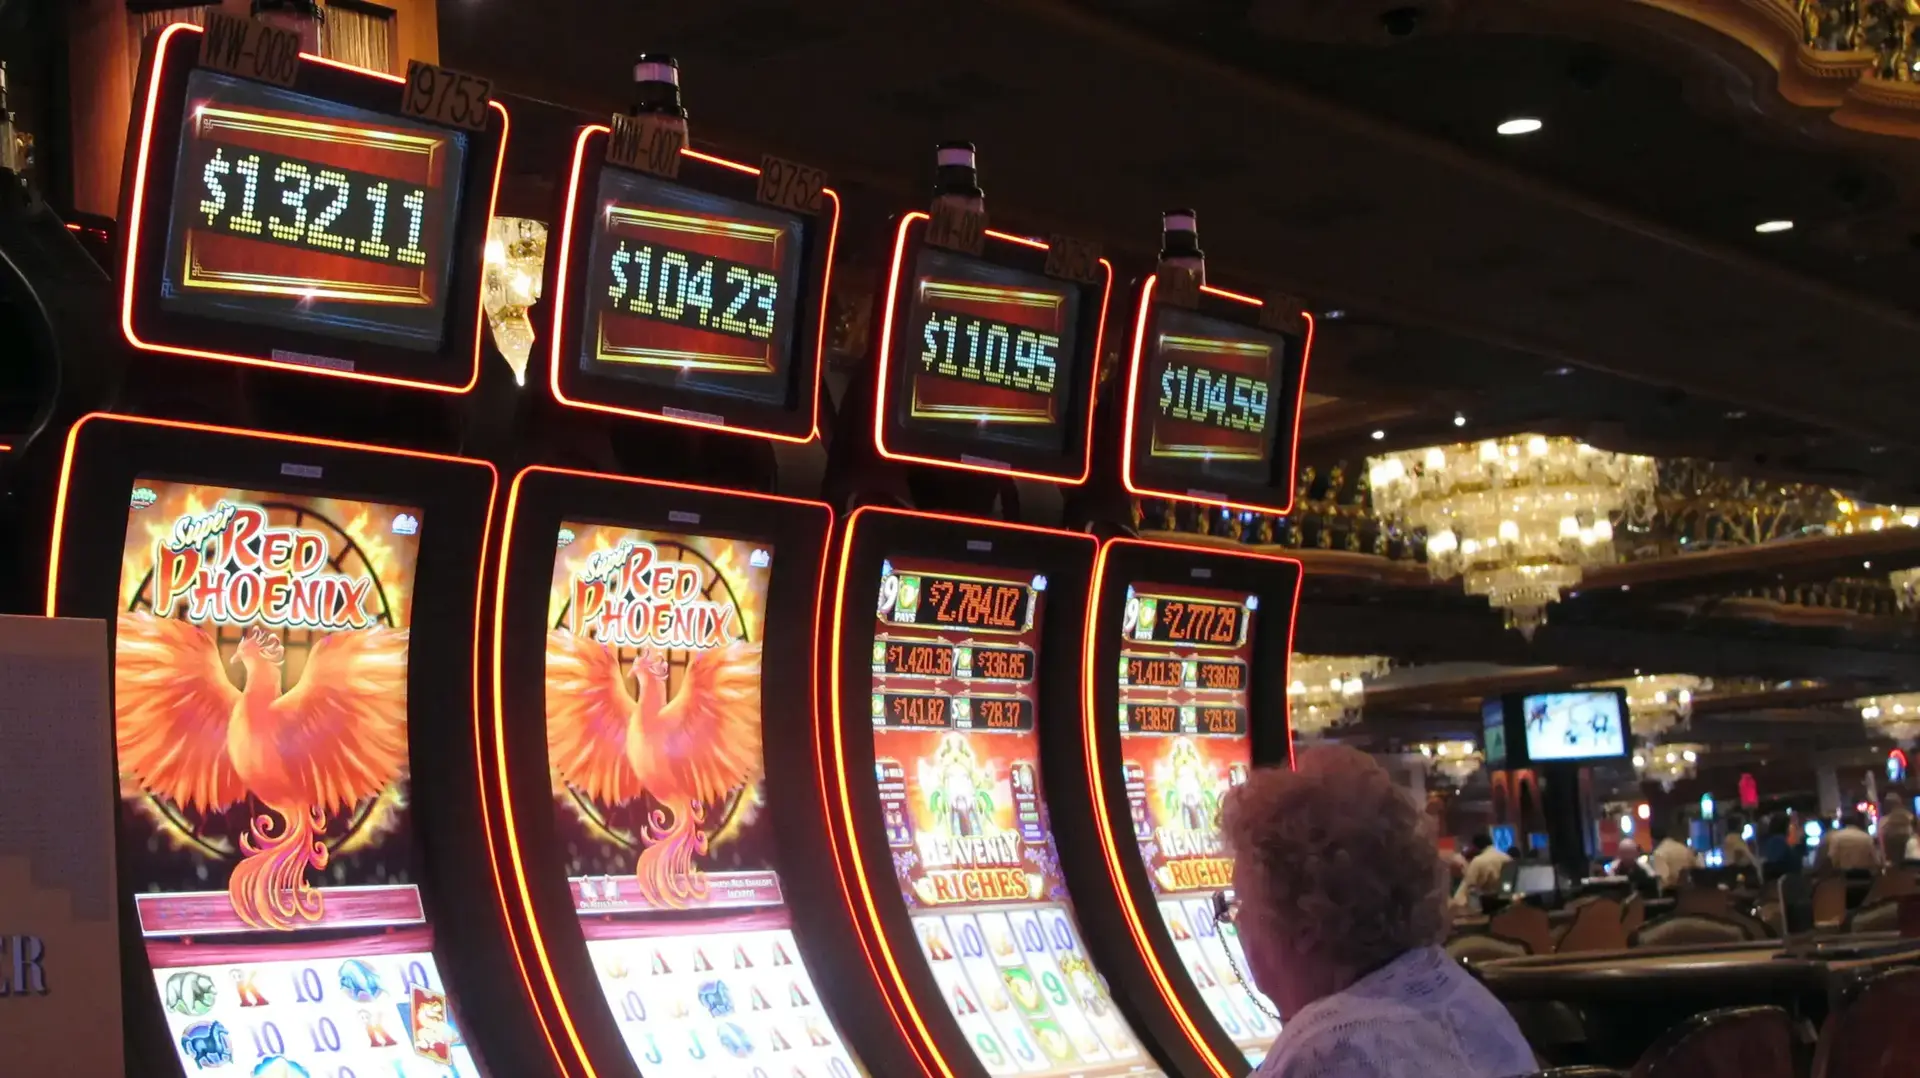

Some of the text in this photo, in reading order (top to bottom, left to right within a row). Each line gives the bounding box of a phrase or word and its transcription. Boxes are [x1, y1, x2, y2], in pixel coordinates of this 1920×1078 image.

[205, 14, 298, 83] WW-008
[404, 64, 490, 126] 19753
[199, 147, 426, 266] $132.11
[608, 240, 778, 339] $104.23
[921, 311, 1060, 393] $110.95
[1159, 361, 1269, 432] $104.59
[172, 502, 236, 552] Super
[218, 508, 327, 577] RED
[154, 542, 372, 629] PHOENIX
[620, 545, 701, 603] RED
[878, 575, 898, 613] 9
[572, 577, 733, 648] PHOENIX
[929, 869, 1029, 902] RICHES
[1167, 857, 1234, 889] RICHE
[957, 923, 983, 958] 10
[1019, 919, 1044, 952] 10
[1048, 917, 1074, 950] 10
[229, 968, 270, 1007] K
[291, 967, 323, 1003] 10
[1041, 970, 1068, 1006] 9
[251, 1020, 285, 1058] 10
[308, 1016, 341, 1053] 10
